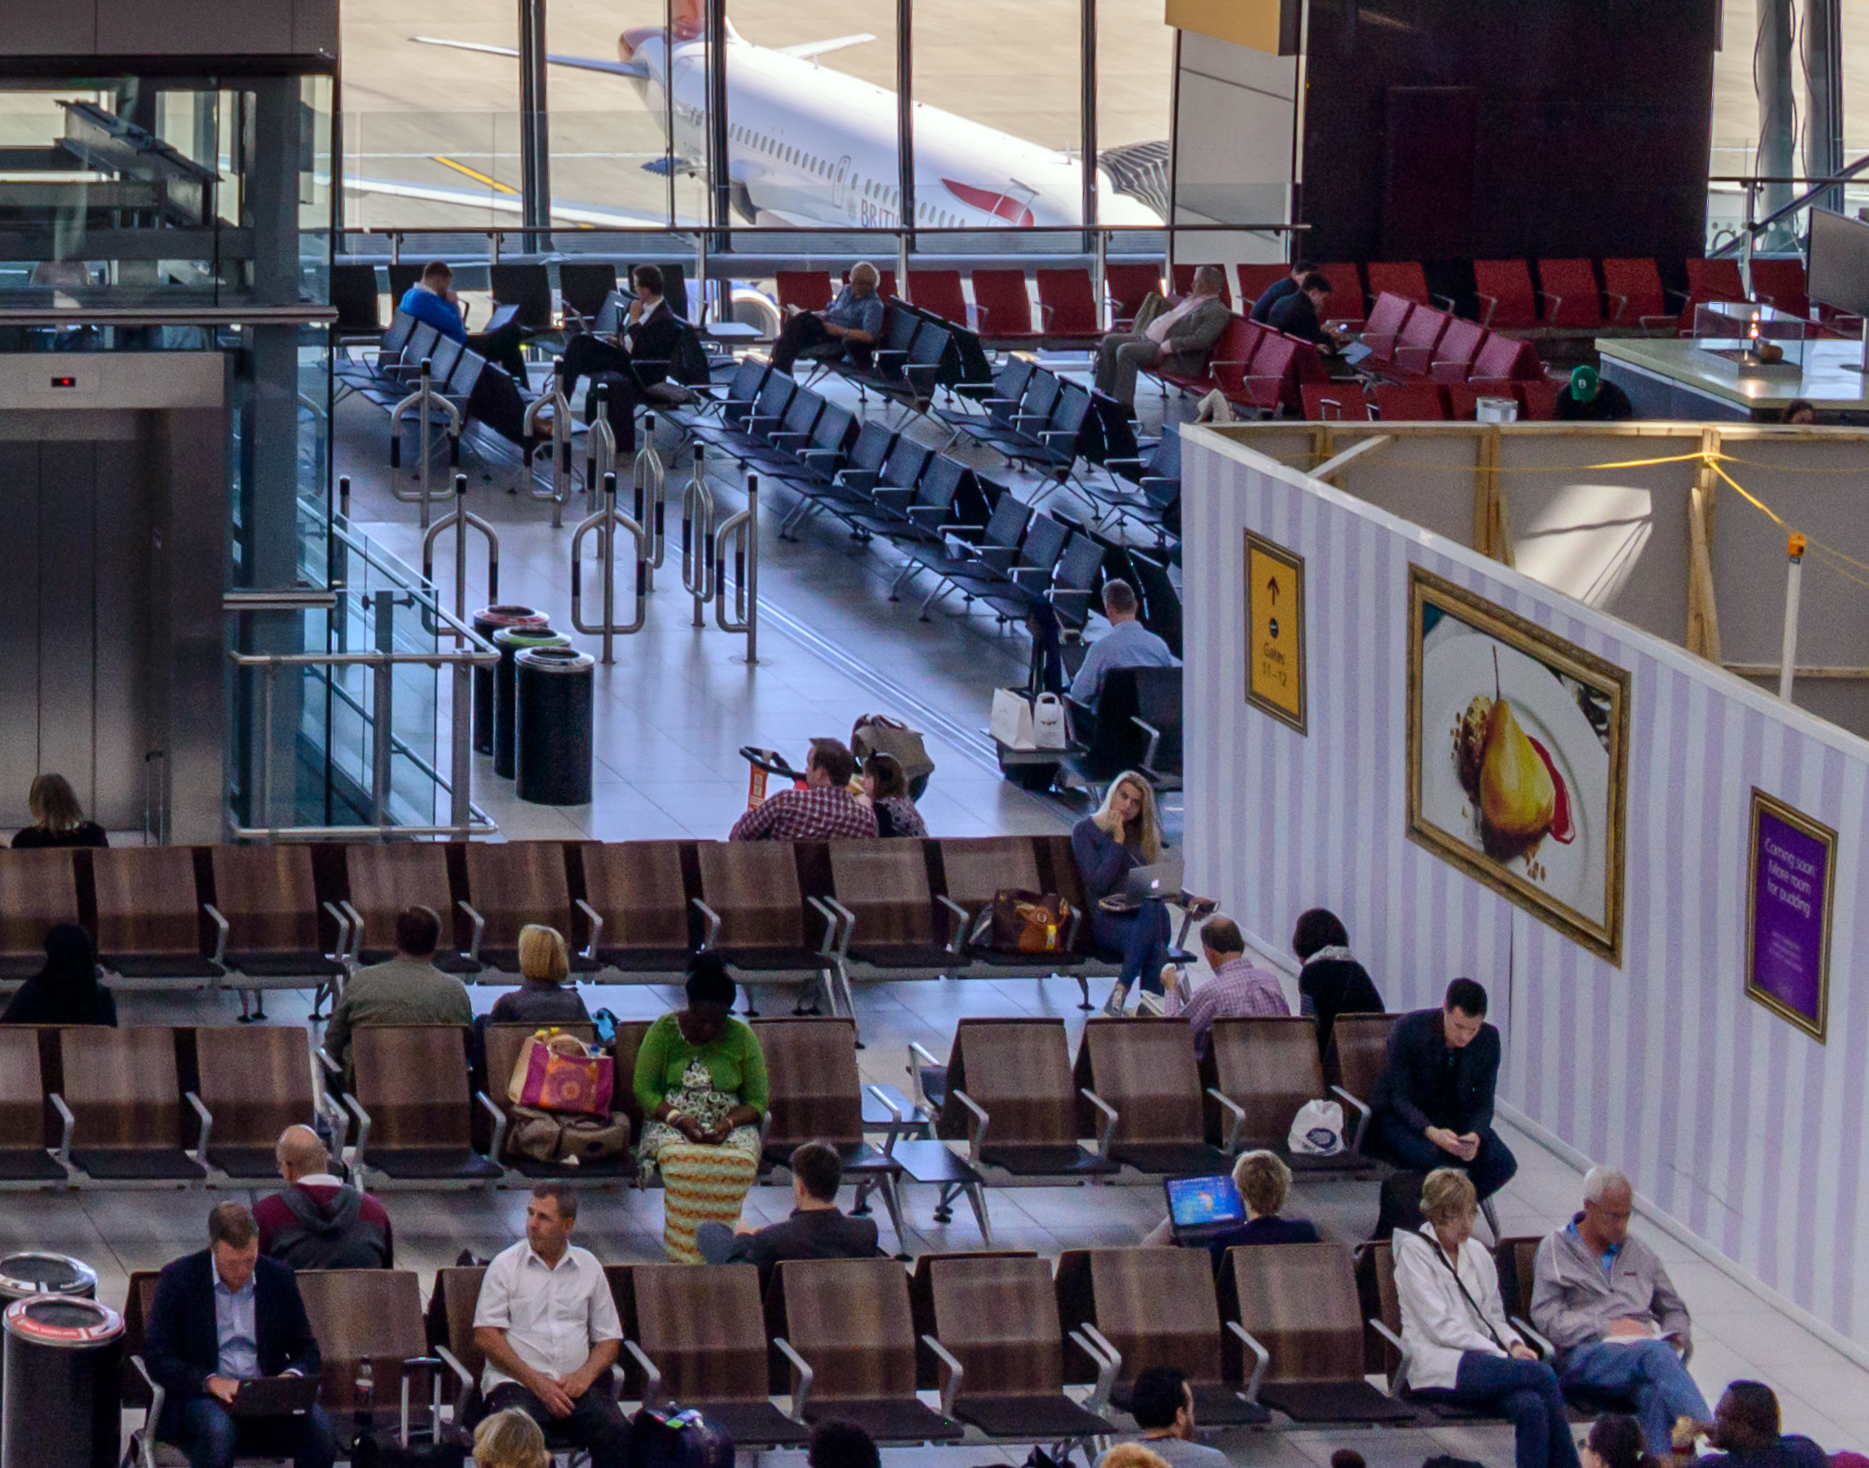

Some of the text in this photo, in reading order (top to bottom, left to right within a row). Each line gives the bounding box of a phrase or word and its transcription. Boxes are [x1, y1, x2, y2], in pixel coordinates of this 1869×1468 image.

[1765, 838, 1795, 870] Coming
[1768, 859, 1811, 895] More room
[1779, 888, 1811, 919] pudding
